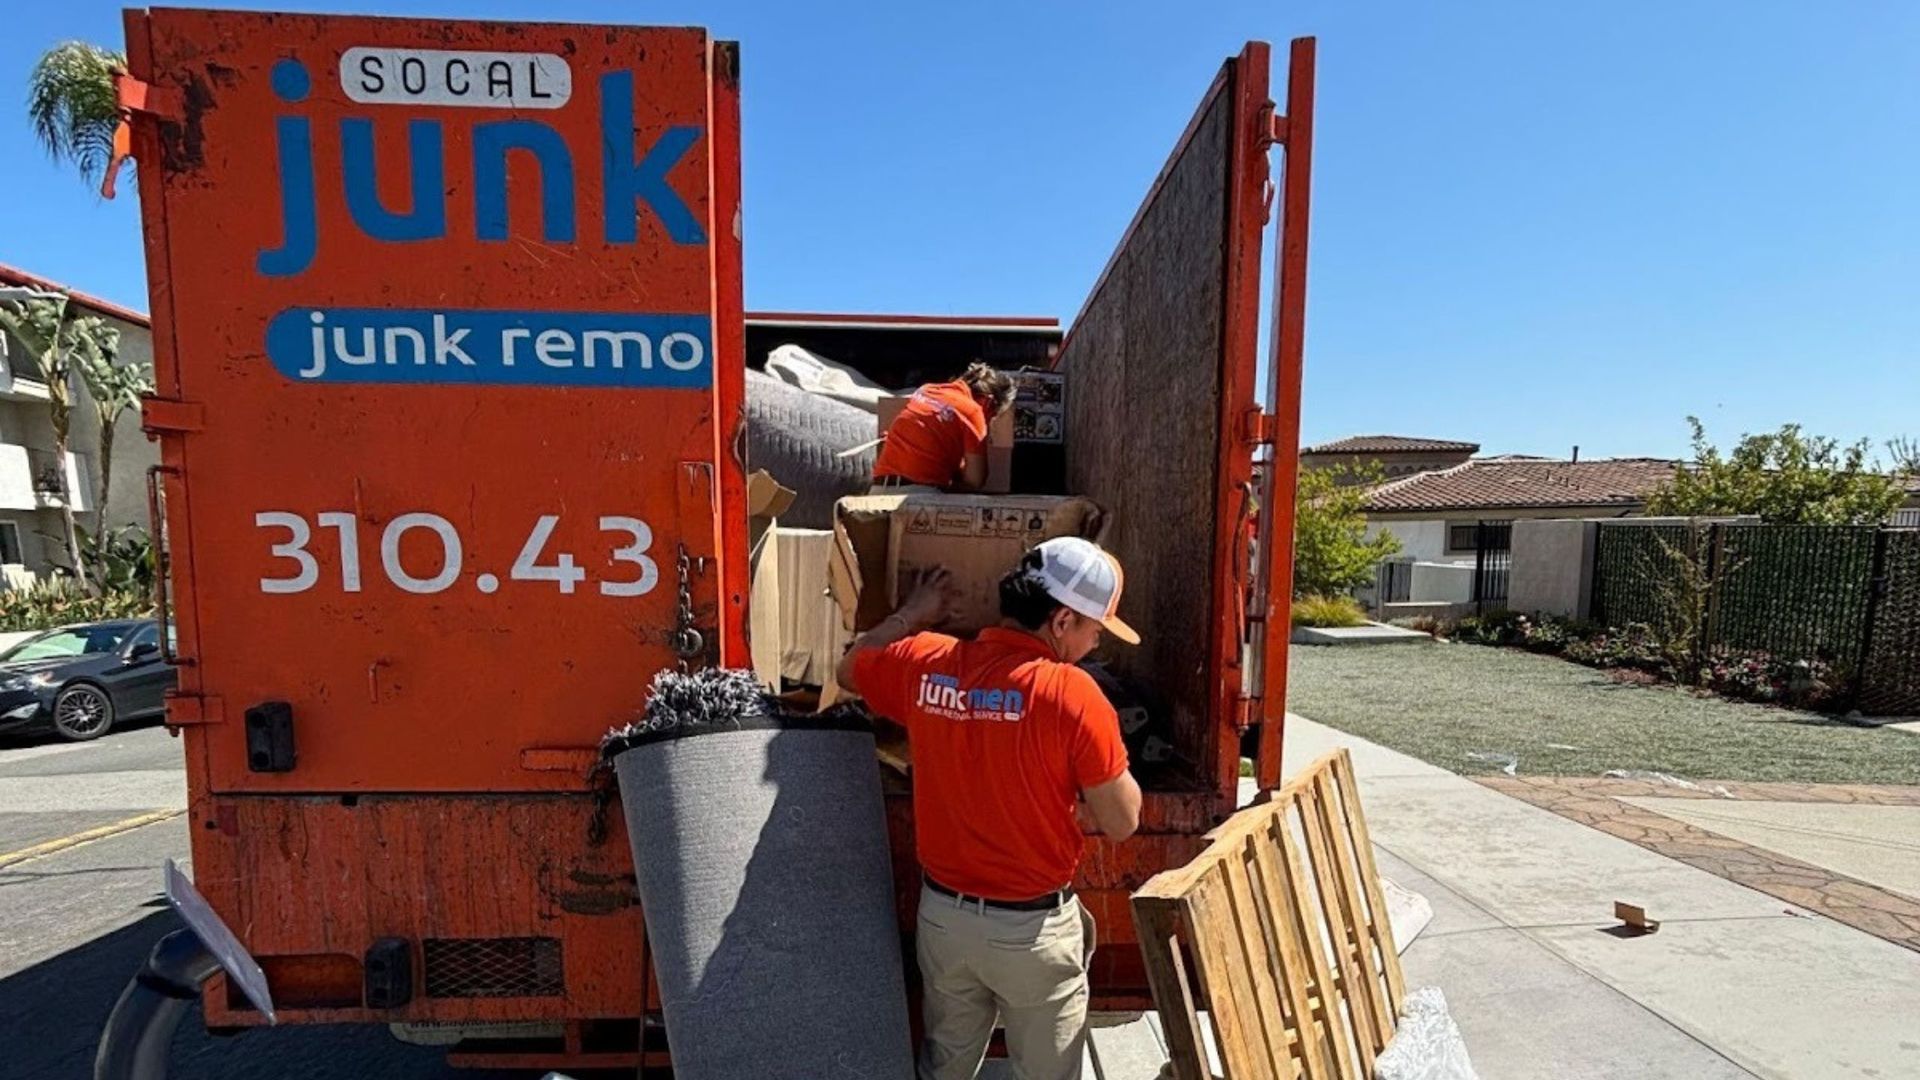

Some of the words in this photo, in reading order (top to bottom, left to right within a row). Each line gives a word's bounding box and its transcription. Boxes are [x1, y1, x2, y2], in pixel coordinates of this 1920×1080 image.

[360, 55, 552, 99] SOCAL
[256, 59, 709, 277] junk
[299, 310, 476, 378] junk
[501, 327, 704, 371] remo
[255, 511, 660, 597] 310.43
